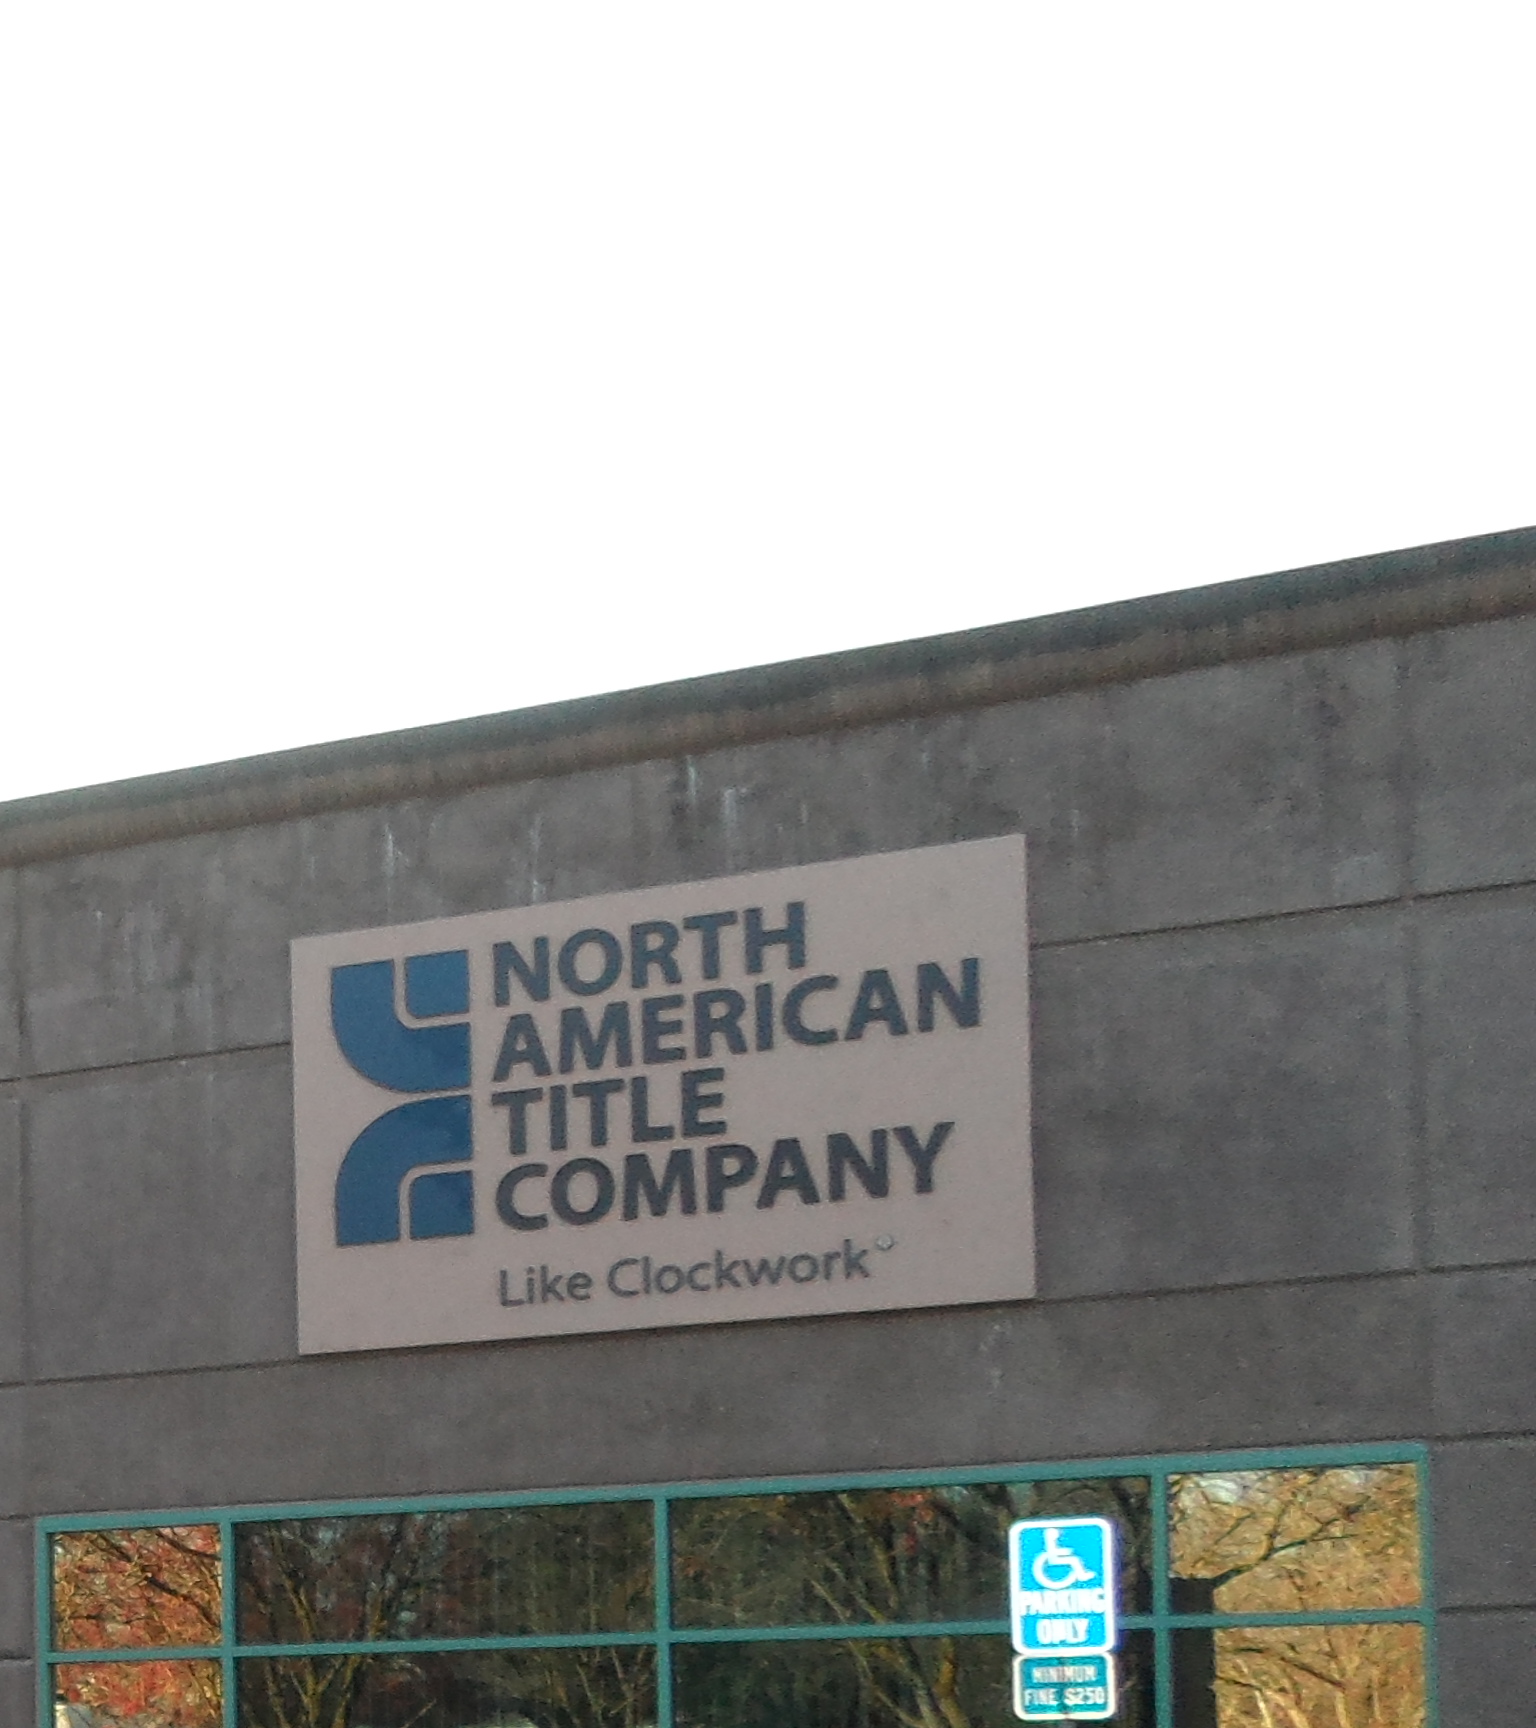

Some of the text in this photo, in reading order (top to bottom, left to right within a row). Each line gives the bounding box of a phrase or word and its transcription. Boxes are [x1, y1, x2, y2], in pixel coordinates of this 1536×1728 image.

[492, 902, 807, 1007] NORTH
[491, 957, 982, 1083] AMERICAN
[492, 1067, 727, 1156] TITLE
[494, 1121, 955, 1232] COMPANY
[498, 1238, 871, 1308] Like Clockwork
[1019, 1588, 1107, 1616] PARKING
[1035, 1618, 1090, 1645] ONLY
[1023, 1686, 1106, 1706] FINE $250
[1032, 1665, 1098, 1684] MINIMUM
